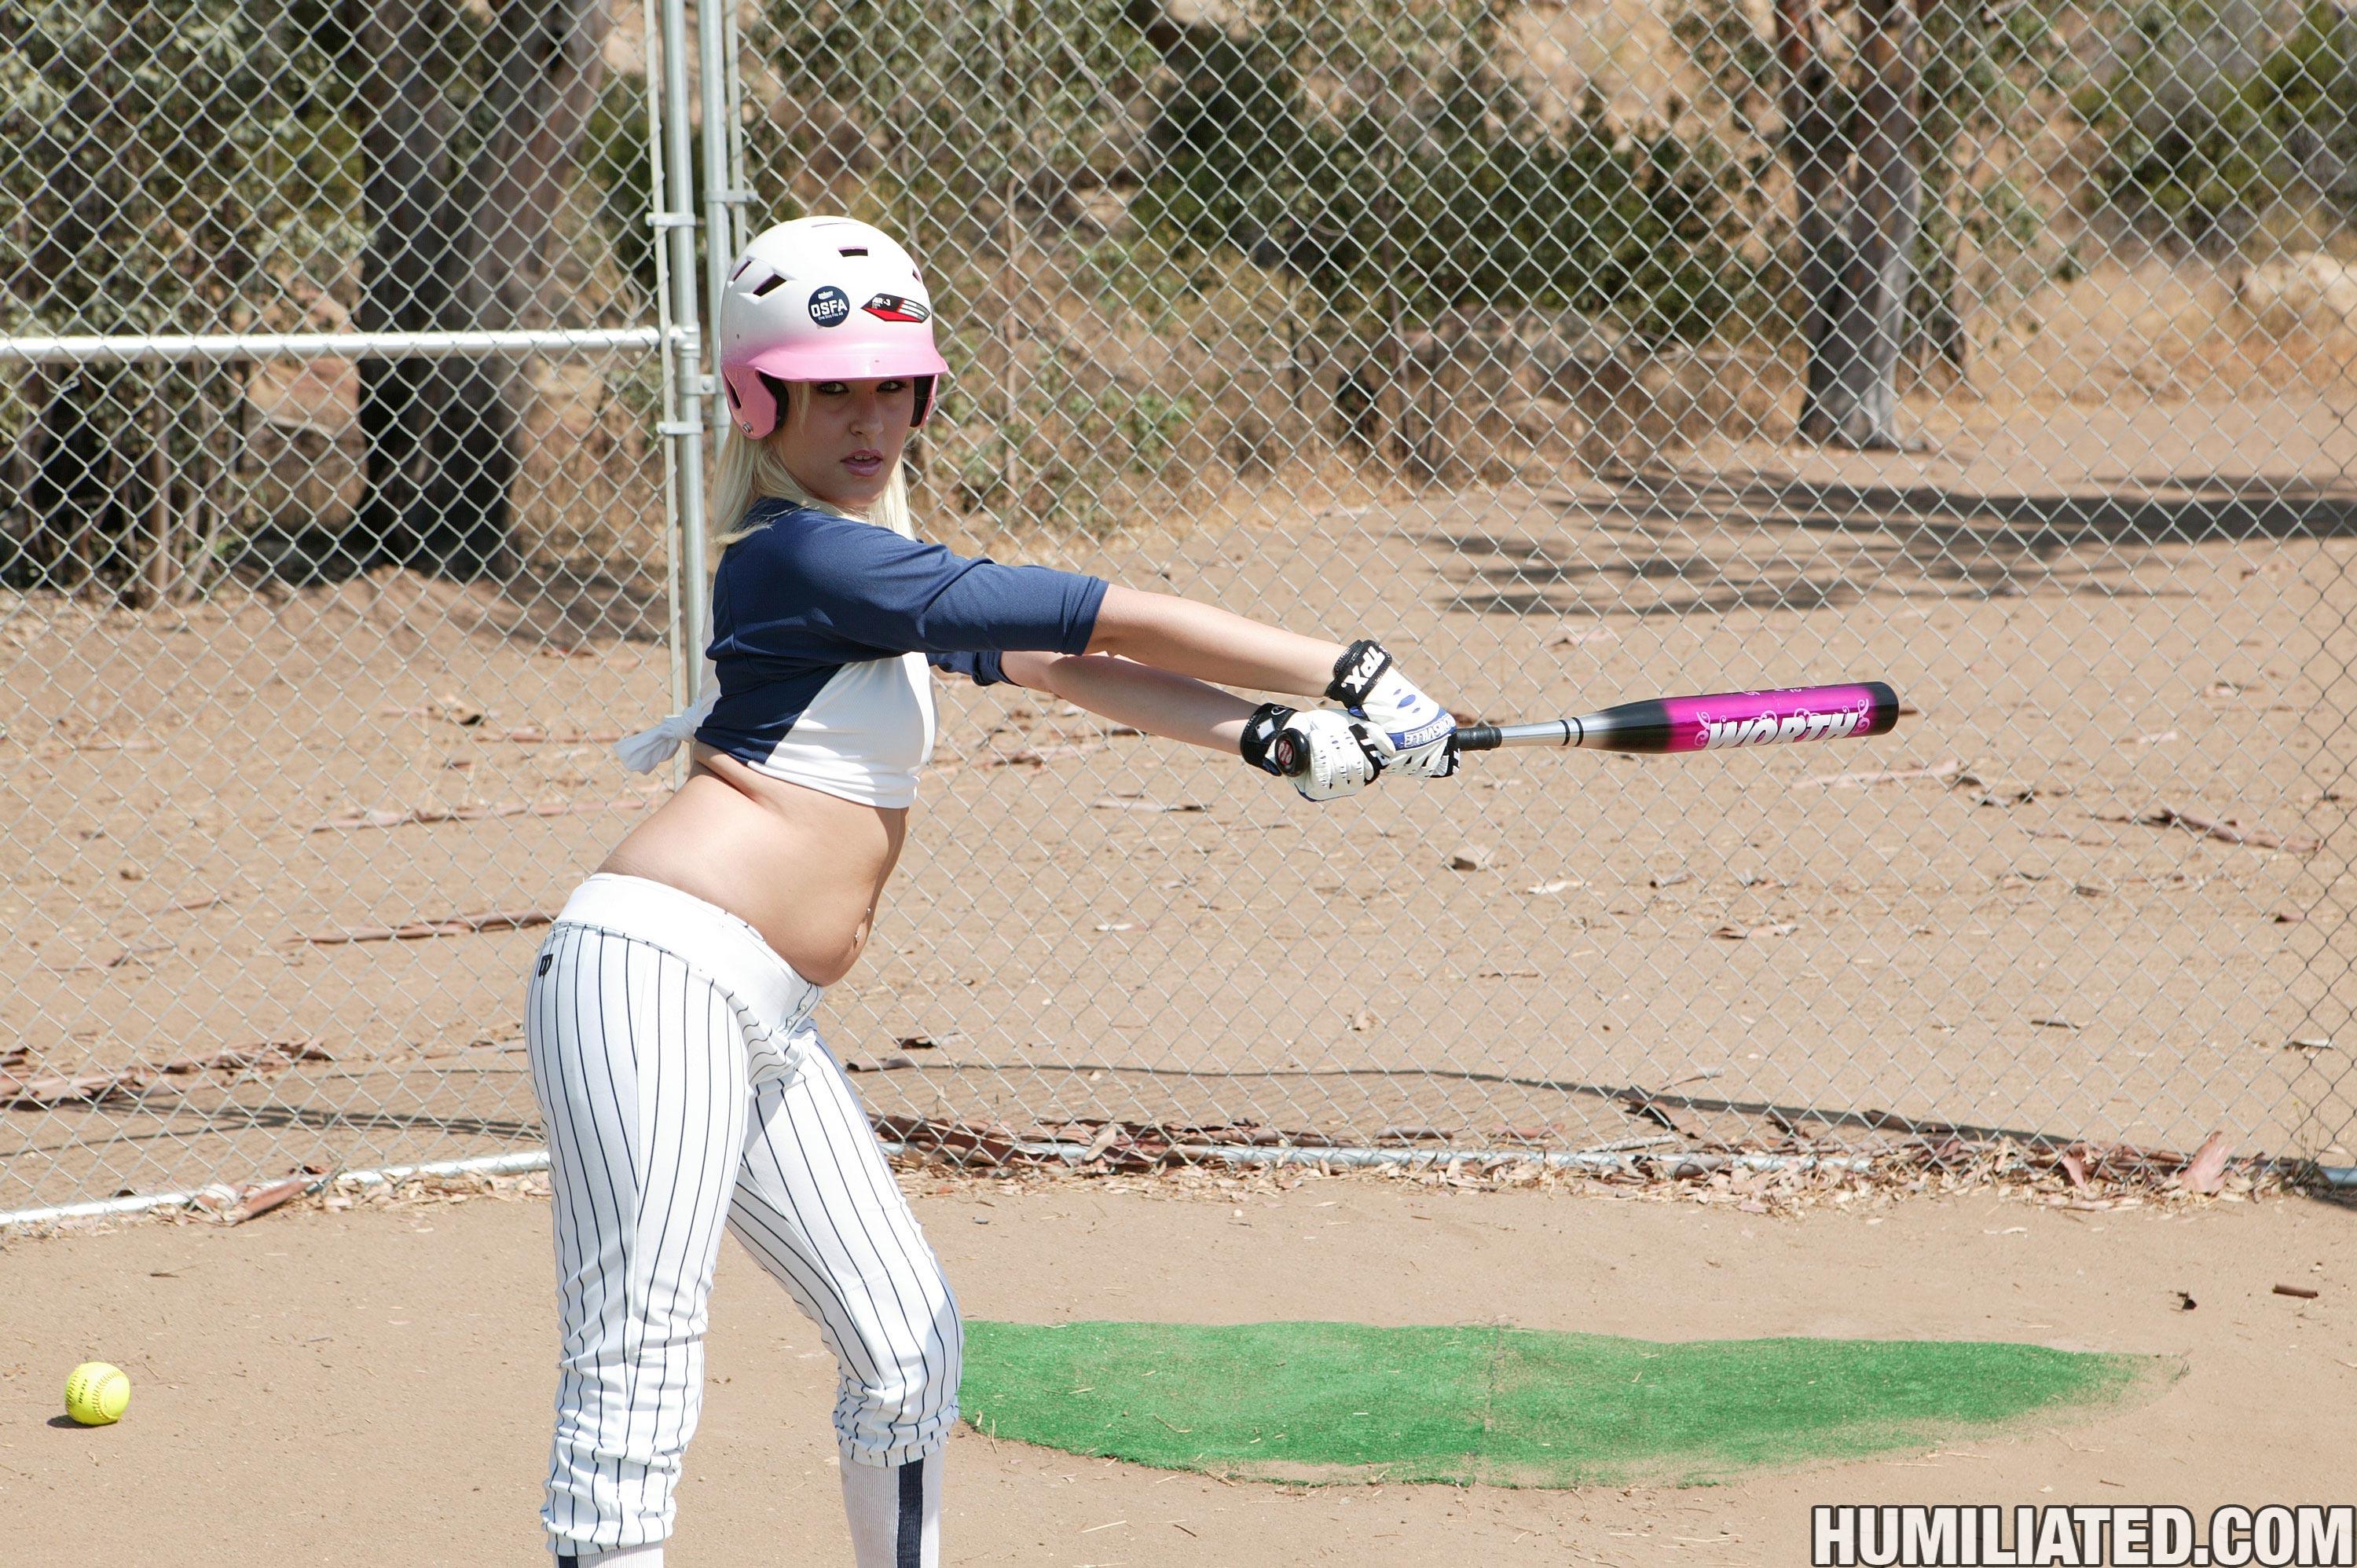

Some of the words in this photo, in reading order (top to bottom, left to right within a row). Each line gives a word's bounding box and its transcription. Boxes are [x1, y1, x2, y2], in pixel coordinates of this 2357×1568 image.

[811, 299, 848, 317] OSFA
[1343, 646, 1386, 694] TPX
[1706, 713, 1860, 749] WORTH
